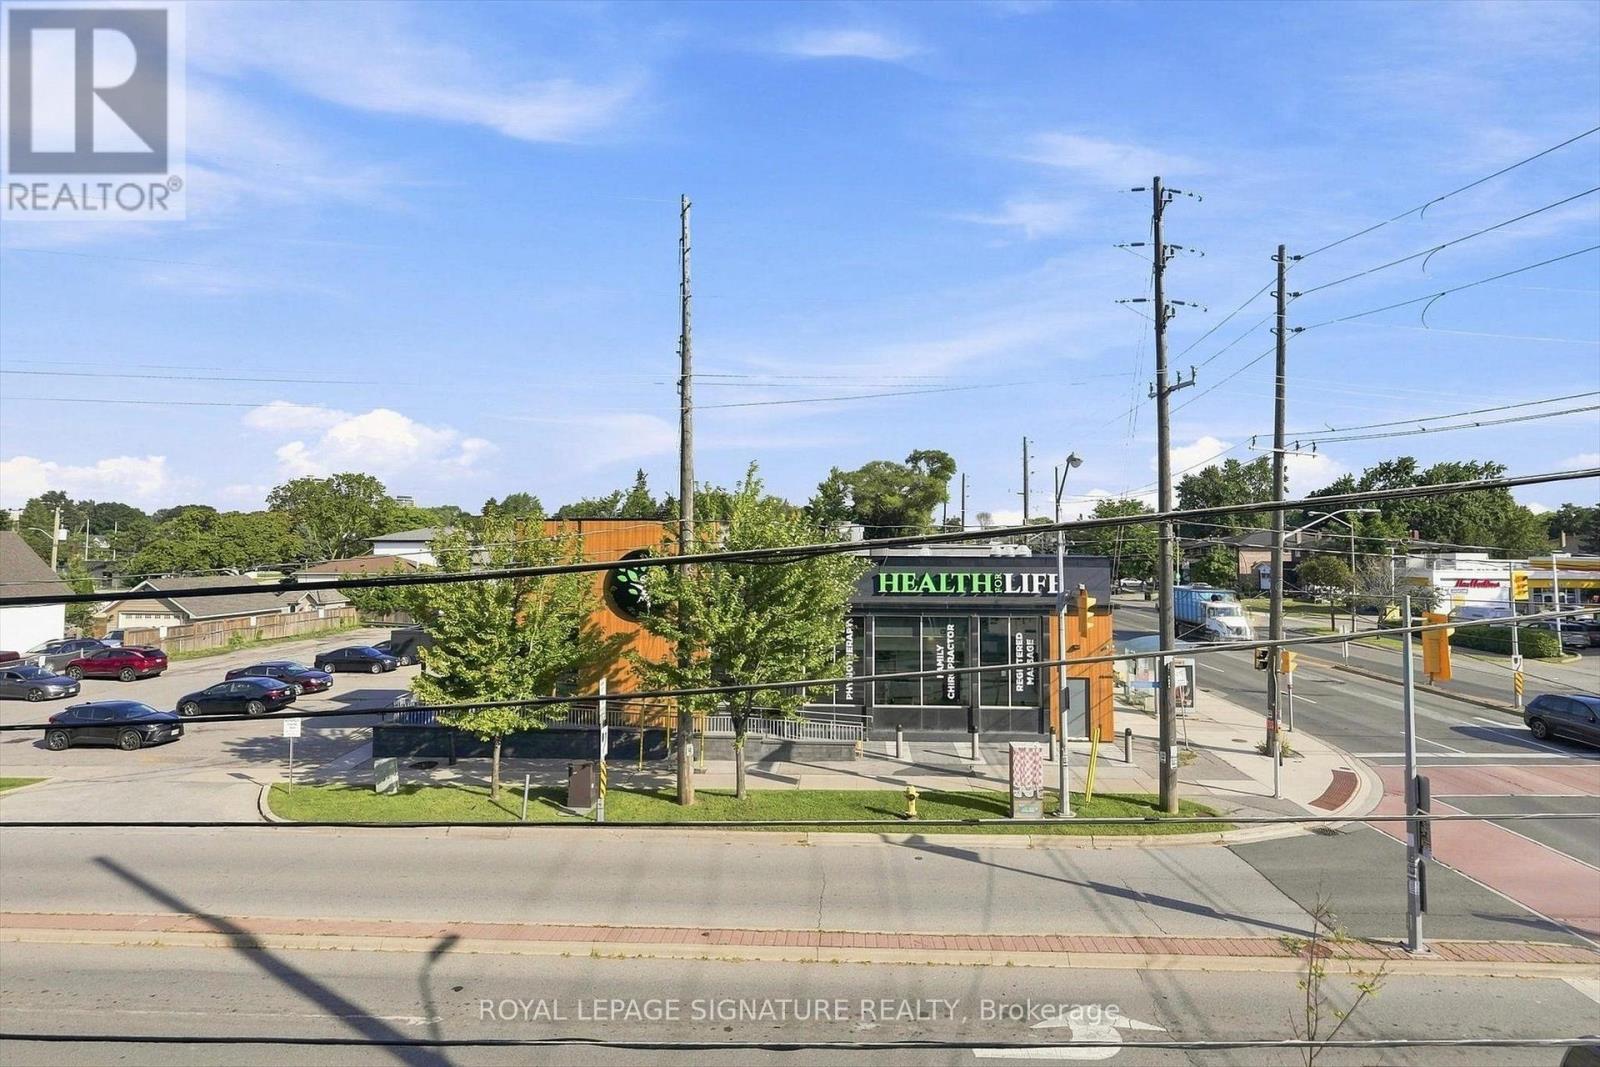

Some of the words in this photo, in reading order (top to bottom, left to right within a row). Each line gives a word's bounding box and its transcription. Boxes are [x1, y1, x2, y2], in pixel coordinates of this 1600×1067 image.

[878, 572, 993, 593] HEALTH
[994, 573, 1003, 593] FOR
[1015, 632, 1024, 691] REGITERED
